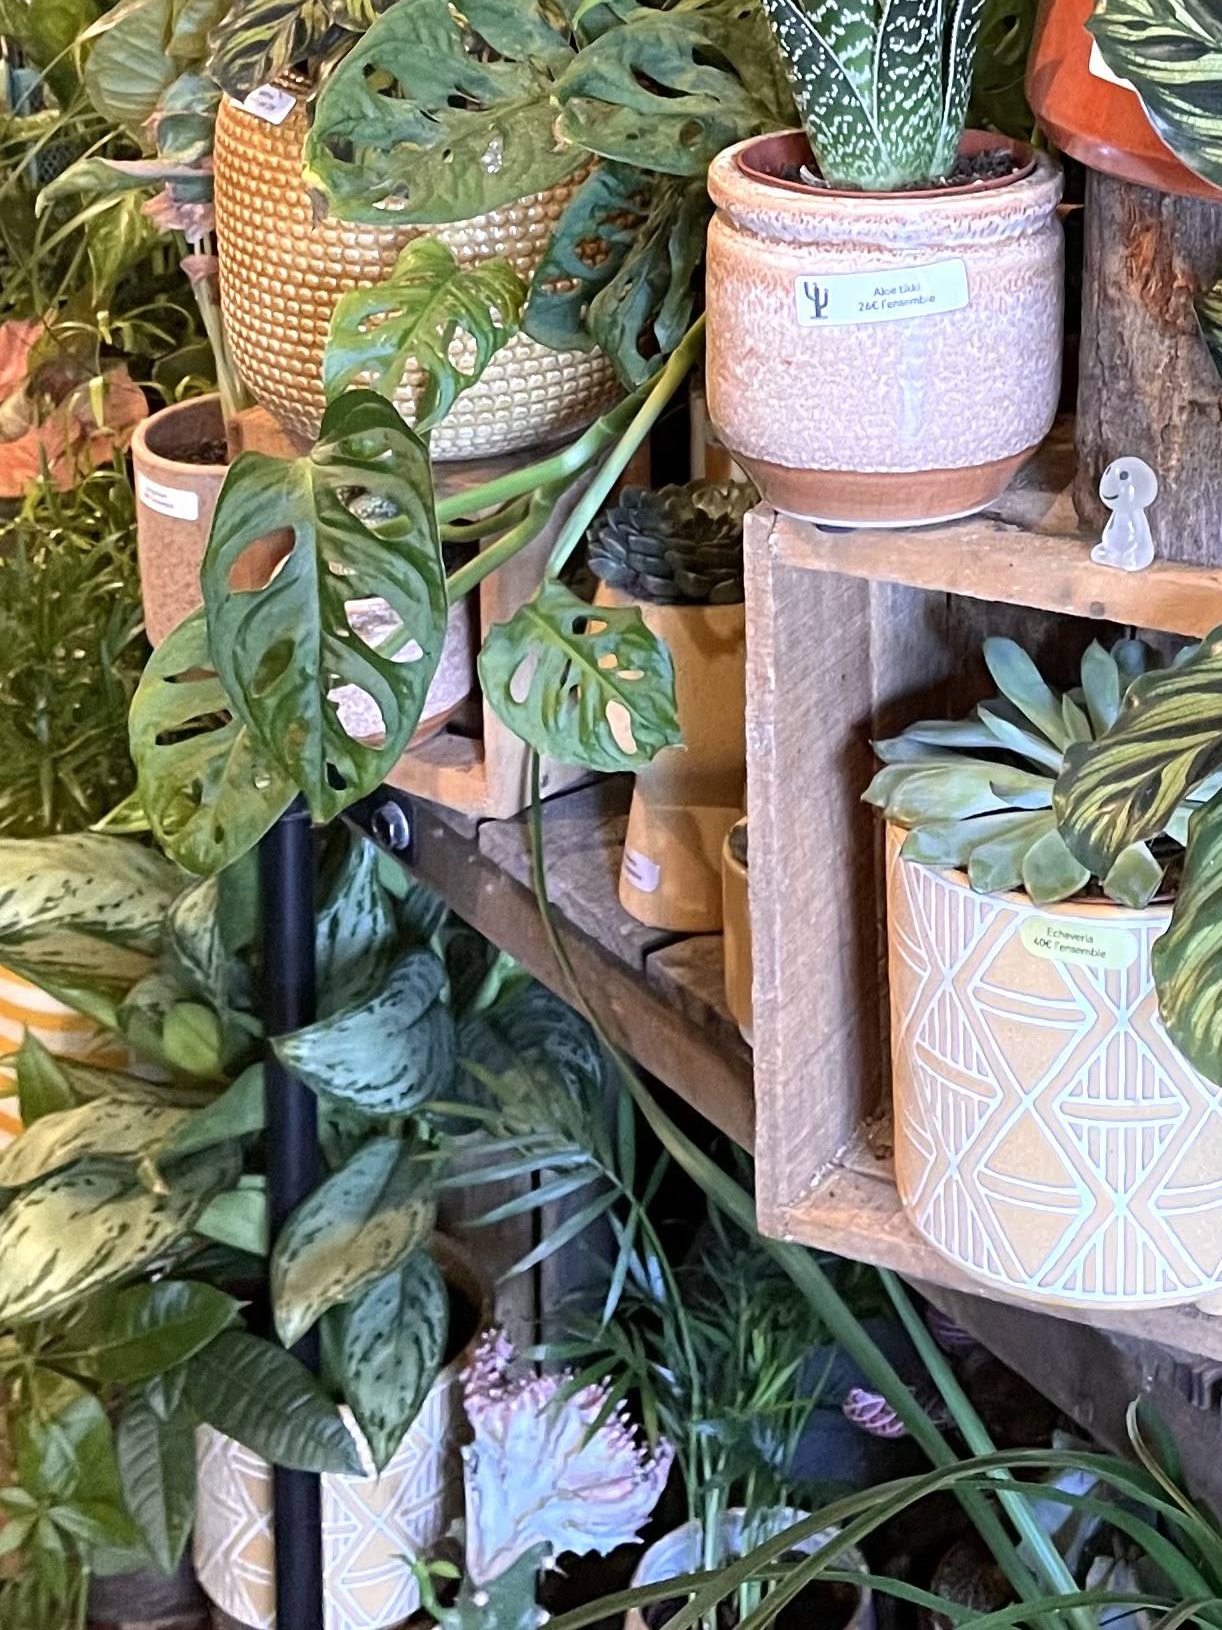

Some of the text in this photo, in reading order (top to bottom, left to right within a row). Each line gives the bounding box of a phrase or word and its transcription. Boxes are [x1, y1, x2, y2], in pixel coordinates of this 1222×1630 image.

[873, 286, 897, 297] Aloe
[881, 295, 936, 310] l'ensemble
[1046, 927, 1094, 944] Echeveria
[1054, 940, 1107, 959] l'ensemble
